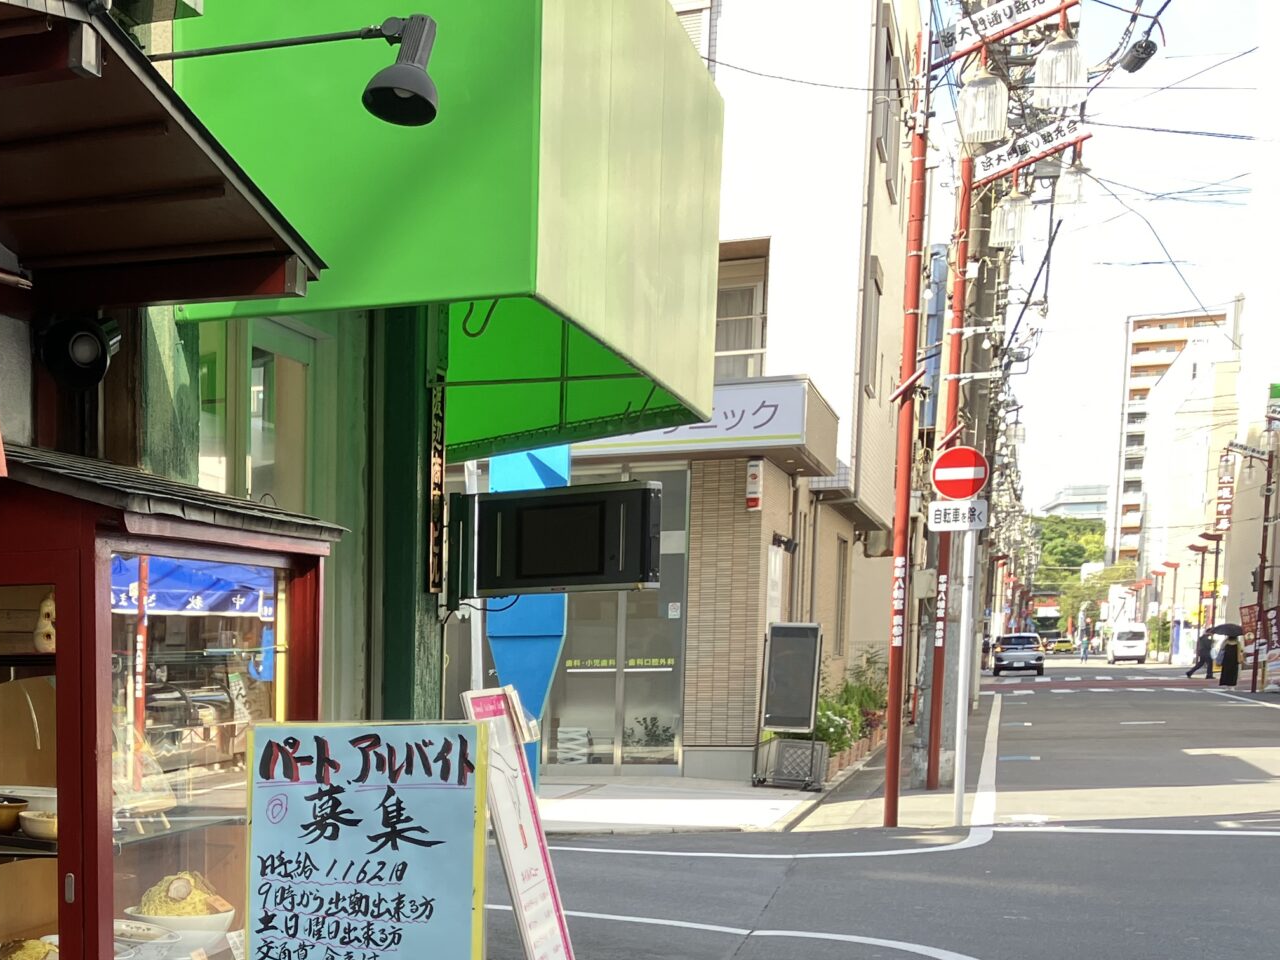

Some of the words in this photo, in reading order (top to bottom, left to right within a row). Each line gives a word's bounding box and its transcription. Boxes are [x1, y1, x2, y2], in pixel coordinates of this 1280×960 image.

[934, 506, 983, 524] 自転車を除く
[297, 785, 446, 855] 募集
